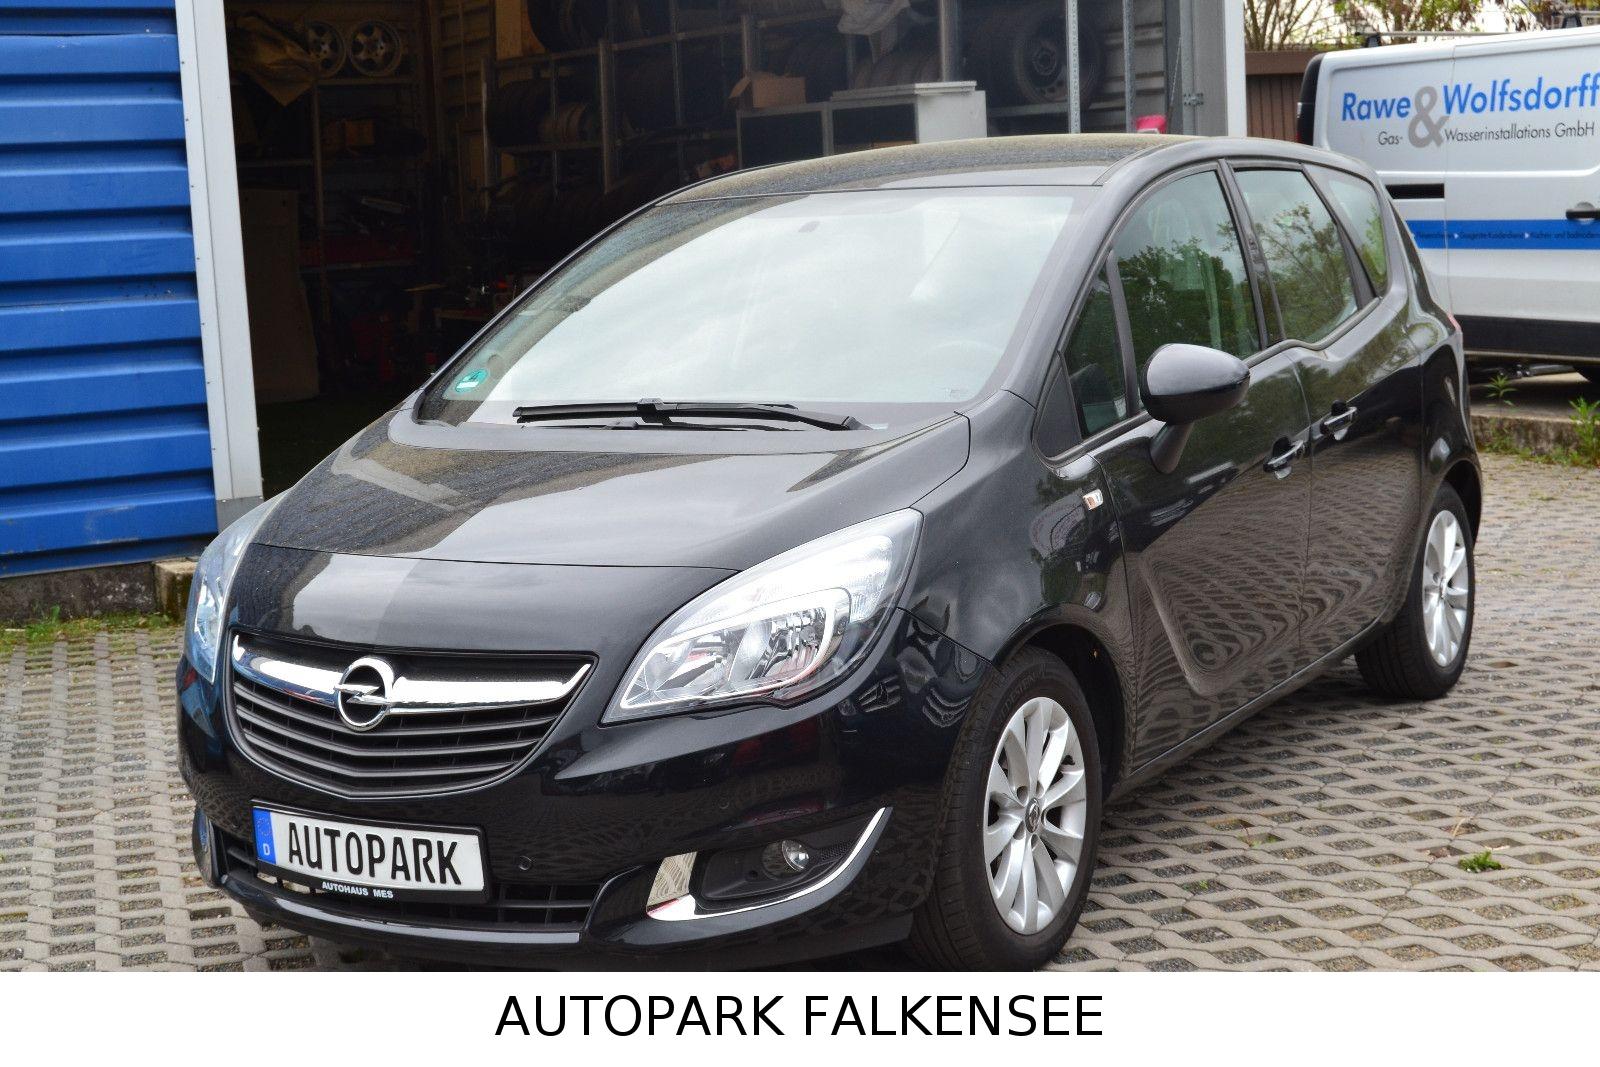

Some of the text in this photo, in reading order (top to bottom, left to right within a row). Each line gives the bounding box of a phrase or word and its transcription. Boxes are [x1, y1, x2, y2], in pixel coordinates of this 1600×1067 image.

[1342, 72, 1600, 148] Rawe & Wolfsdorff
[1378, 121, 1595, 146] Gas- Wasserinstallations GmbH
[262, 821, 462, 886] D AUTOPARK
[322, 881, 394, 899] AUTOHAUS MES
